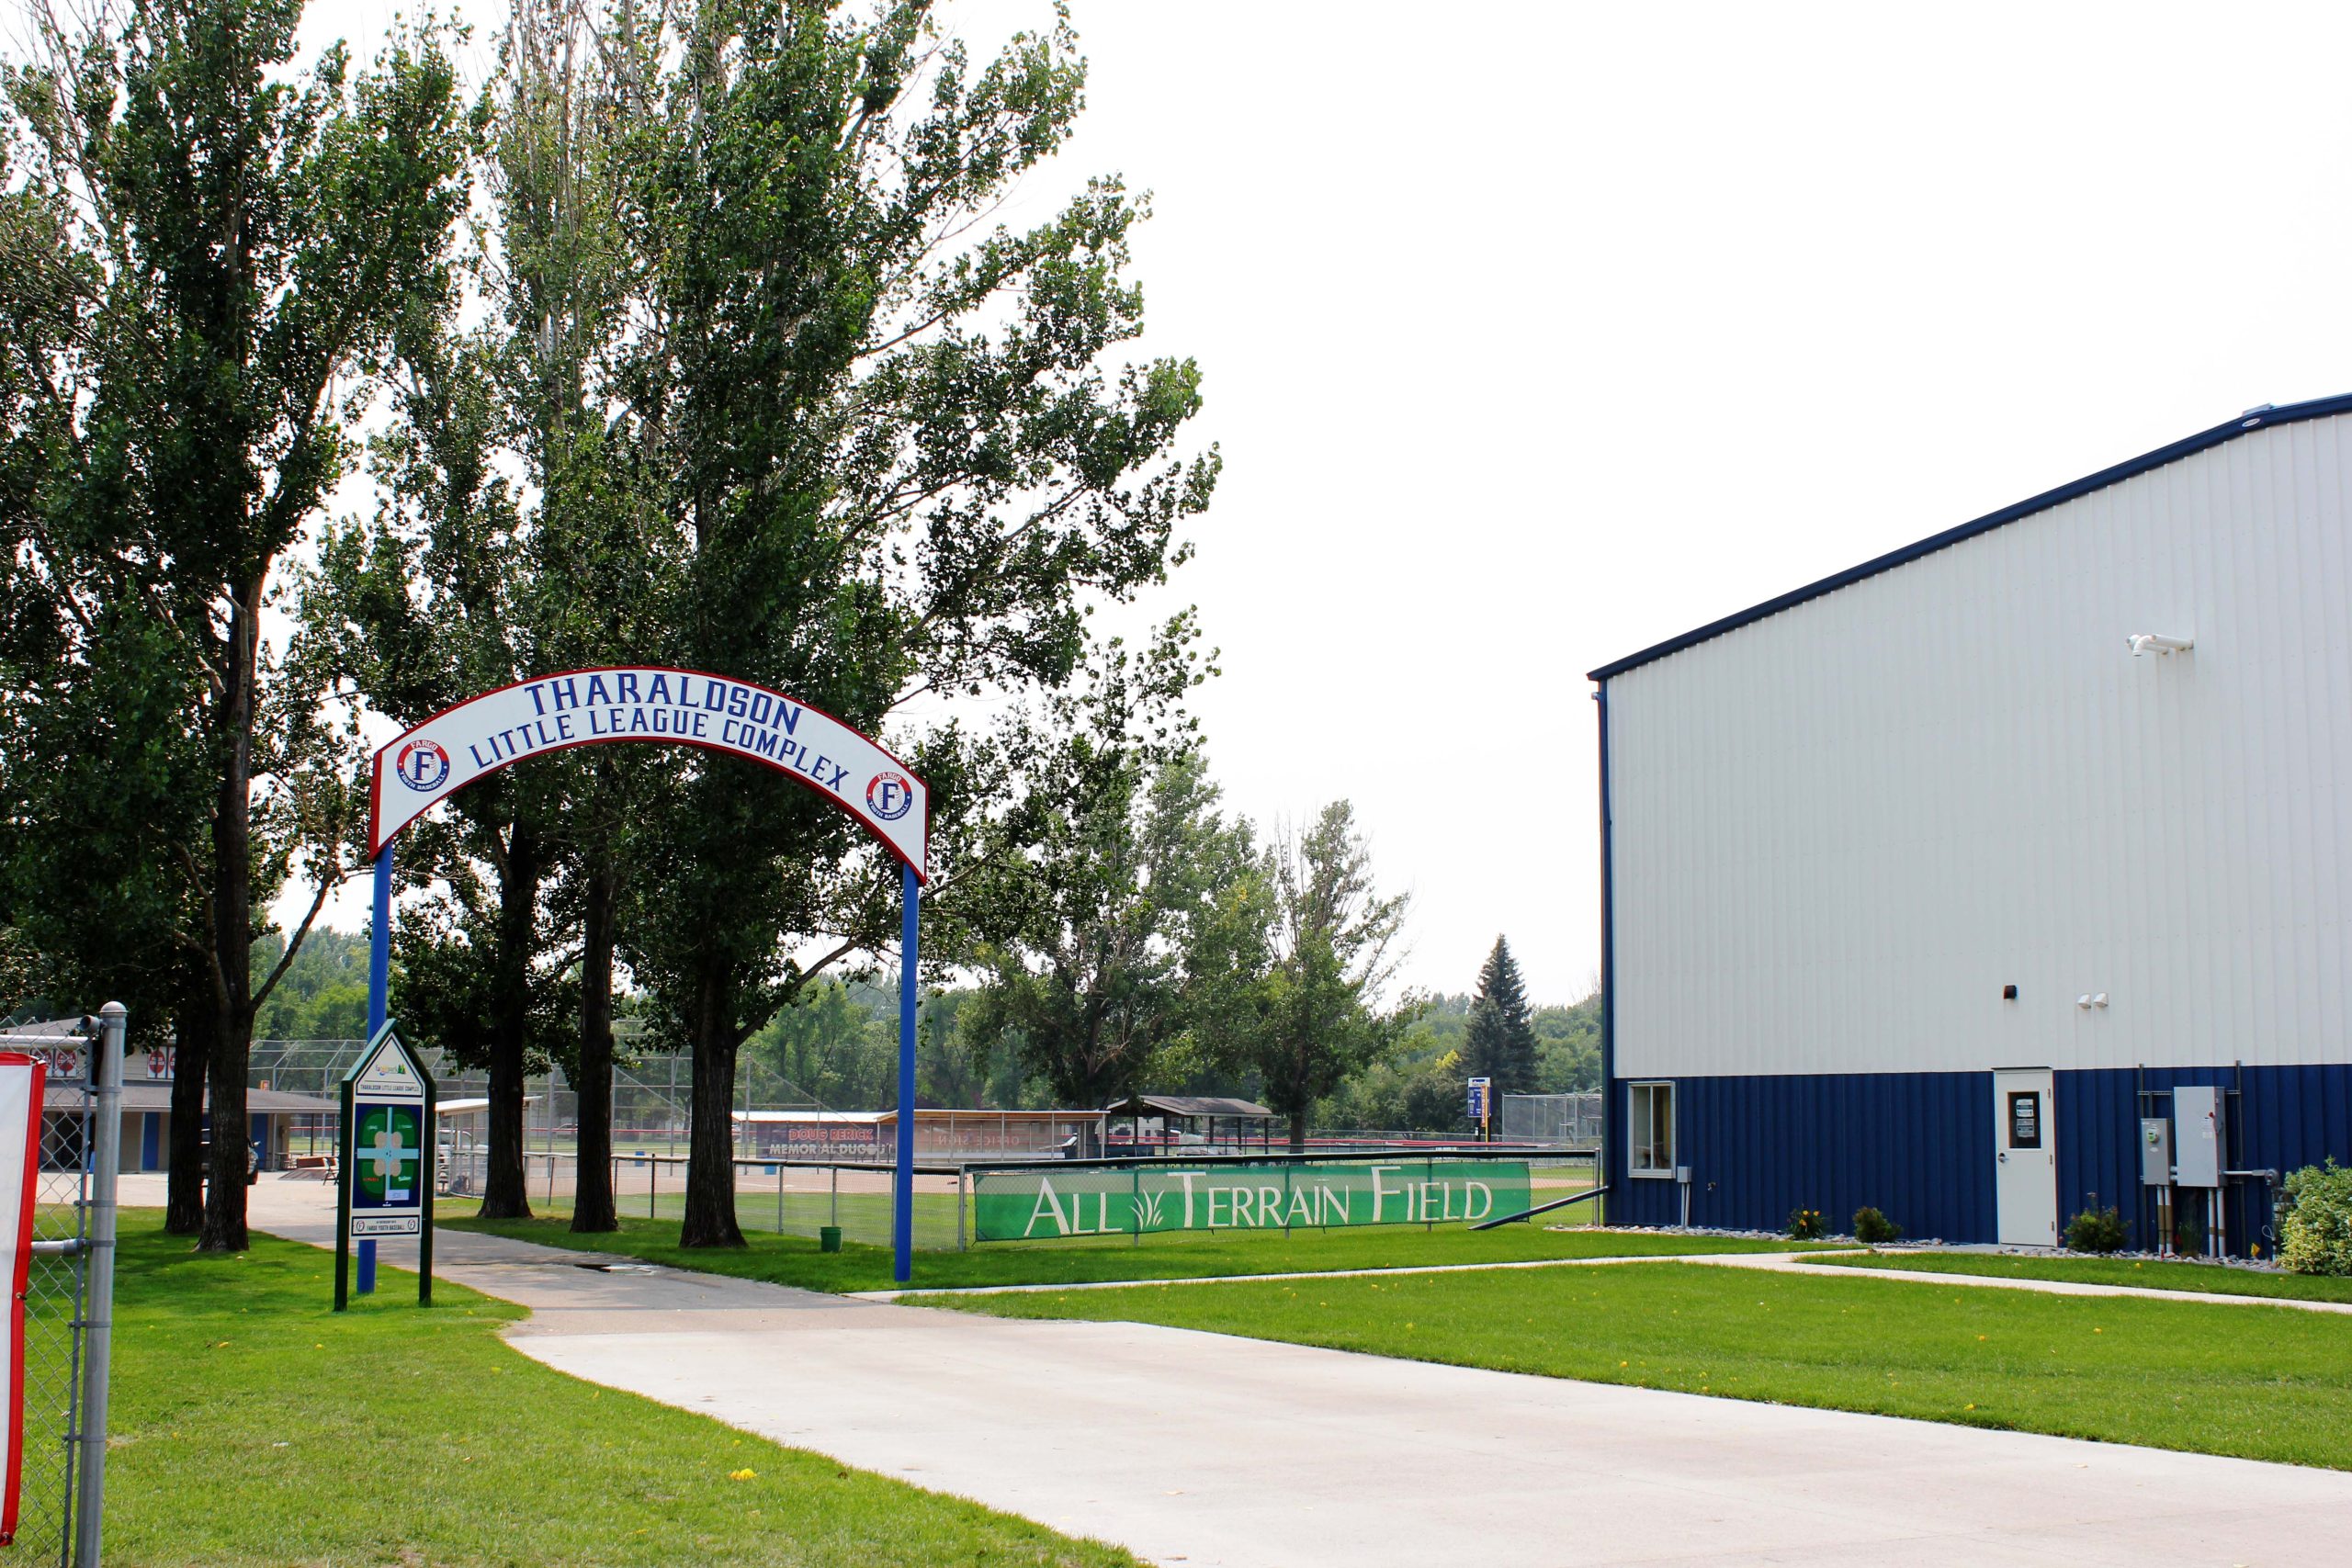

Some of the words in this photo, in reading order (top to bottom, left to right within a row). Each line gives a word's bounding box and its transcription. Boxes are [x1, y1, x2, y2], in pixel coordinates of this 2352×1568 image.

[525, 672, 803, 736] THARALDSON
[411, 739, 439, 750] FARGO
[469, 714, 575, 769] LITTLE
[589, 707, 708, 738] LEAGUE
[722, 719, 850, 792] COMPLEX
[413, 750, 435, 781] F
[876, 772, 902, 782] FARGO
[399, 770, 417, 788] YOUTH
[416, 773, 447, 790] BASEBALL
[880, 782, 899, 810] F
[868, 800, 884, 818] YOUTH
[884, 803, 910, 819] BASEBALL
[788, 1128, 829, 1141] DOUG
[830, 1128, 874, 1141] RERICK
[1023, 1176, 1124, 1237] ALL
[1167, 1171, 1350, 1230] TERRAIN
[1371, 1166, 1493, 1223] FIELD
